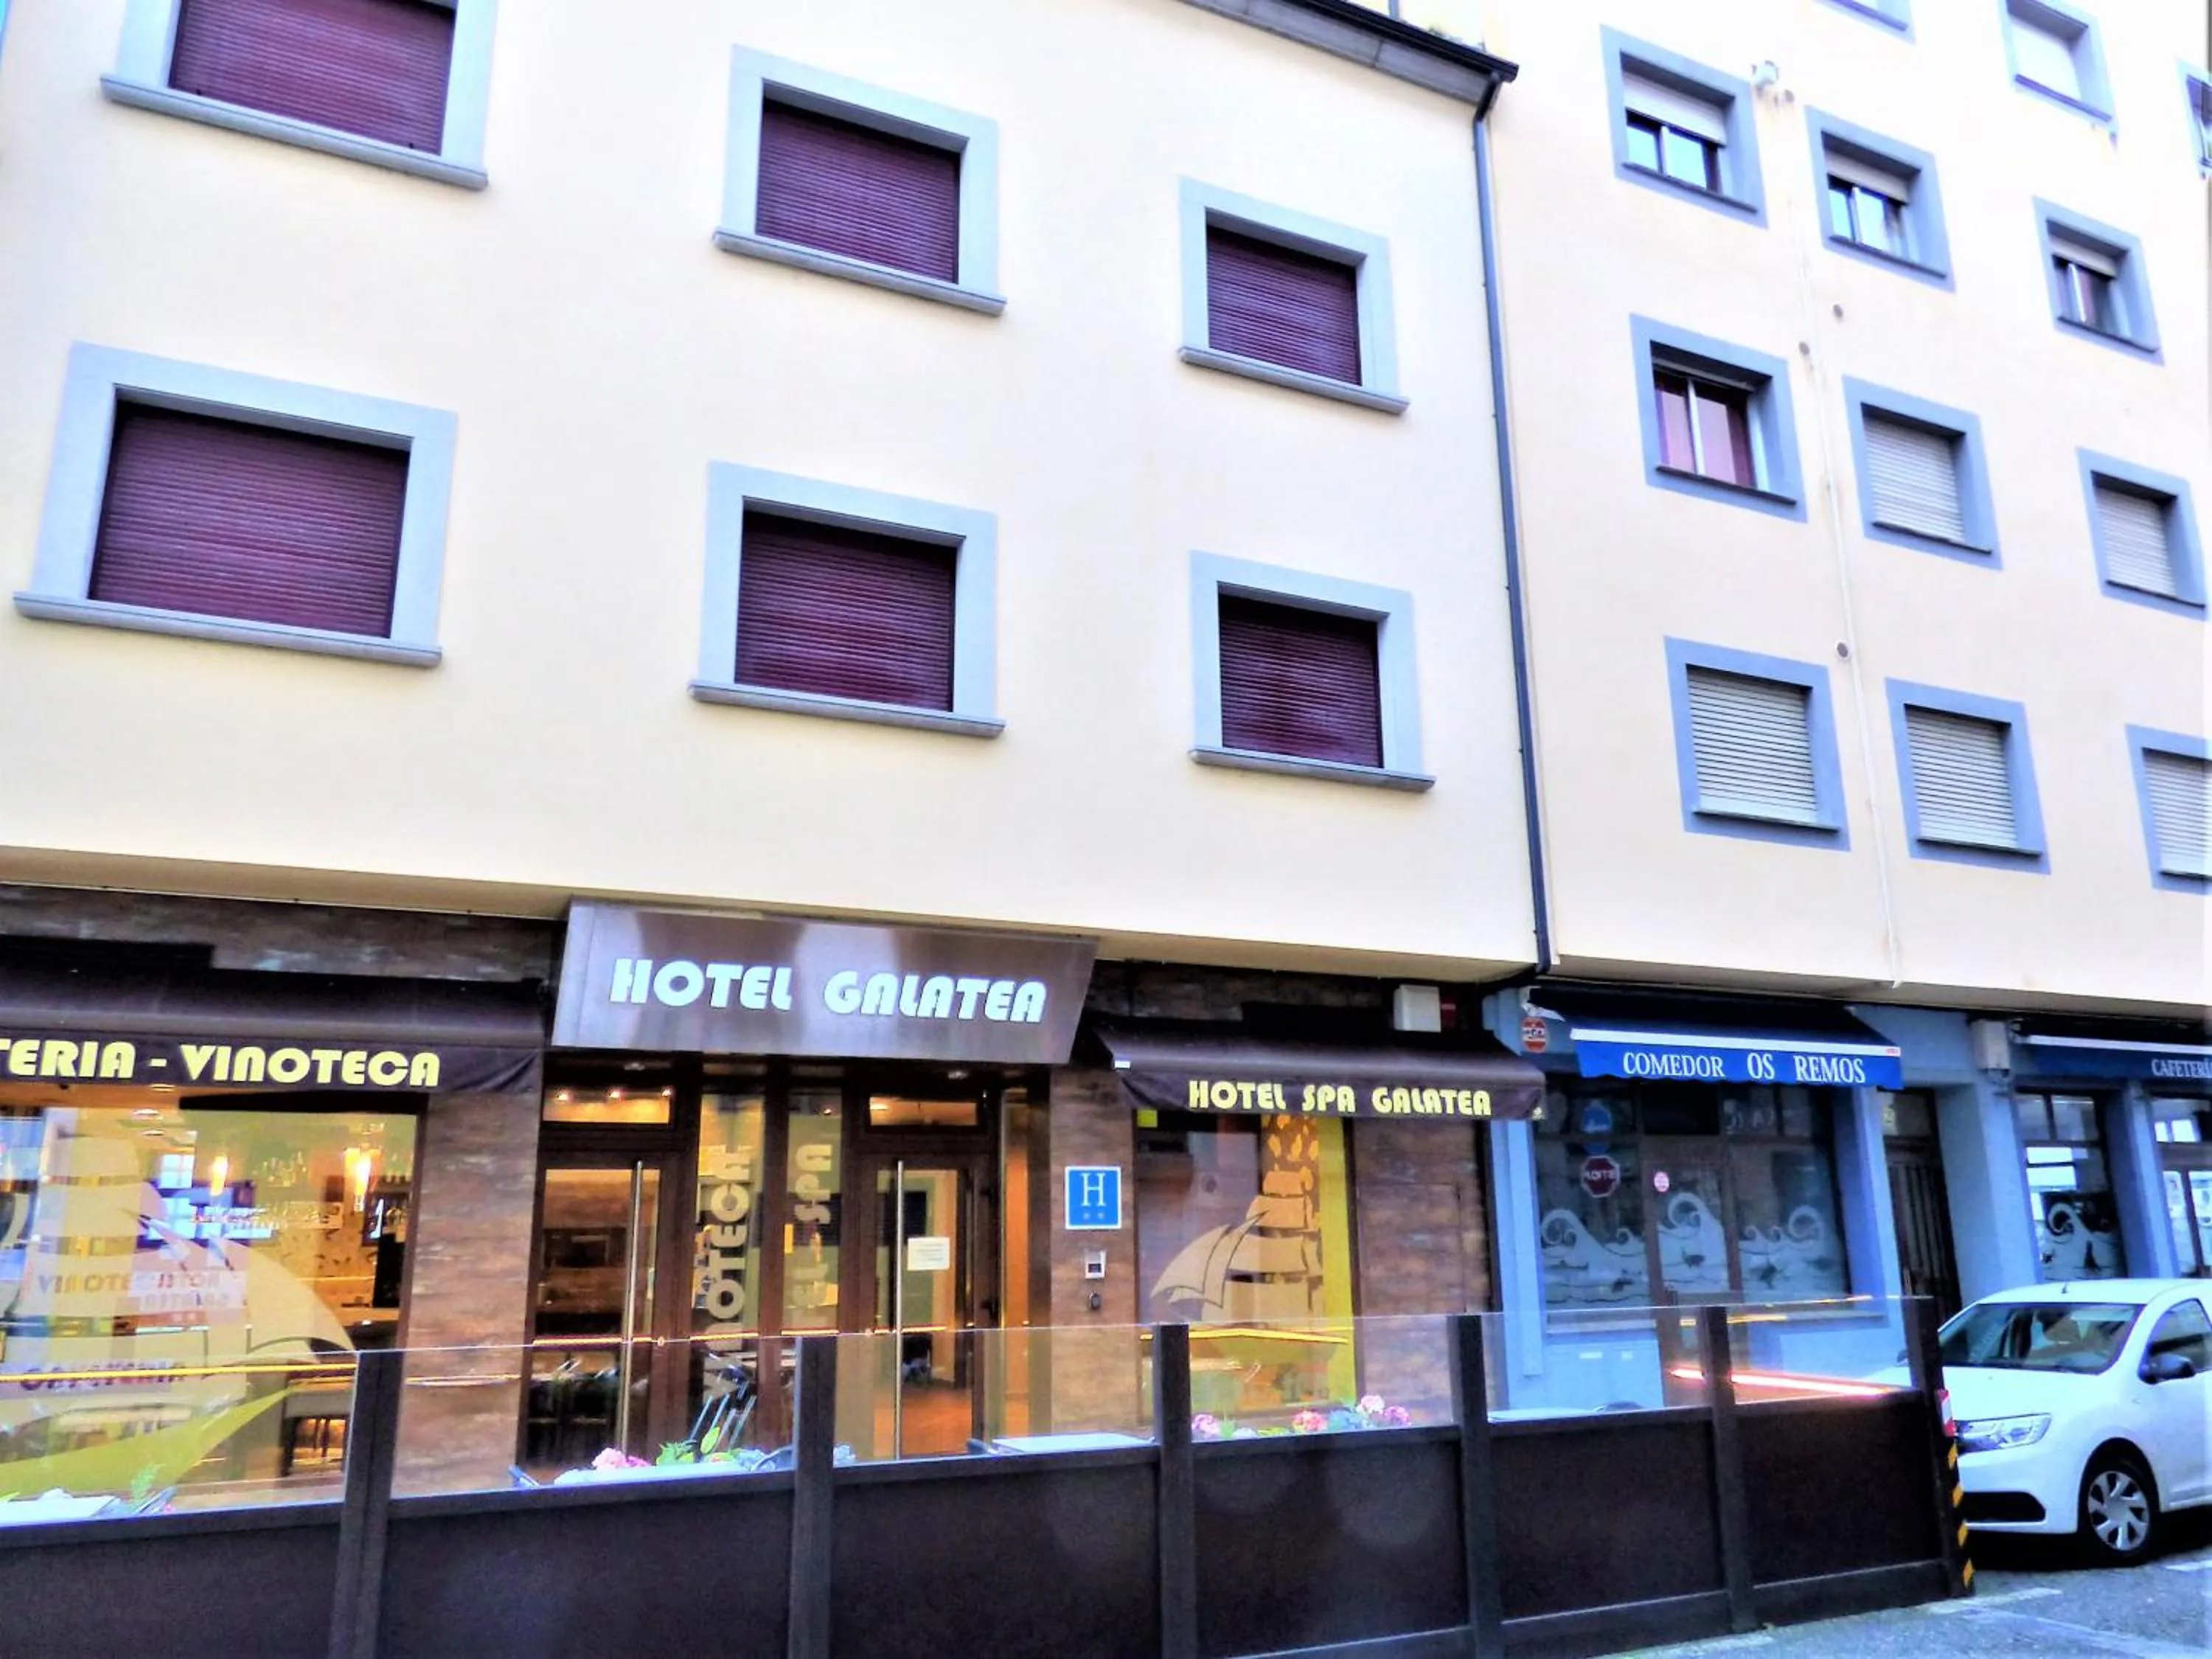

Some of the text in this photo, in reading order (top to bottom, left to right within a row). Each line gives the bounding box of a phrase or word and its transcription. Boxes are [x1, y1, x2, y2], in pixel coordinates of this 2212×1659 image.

[610, 957, 1047, 1023] HOTEL GALATEA
[179, 1044, 441, 1088] VINOTECA
[1623, 1052, 1866, 1084] COMEDOR OS REMOS
[1189, 1079, 1492, 1116] HOTEL SPA GALATEA
[1081, 1172, 1106, 1207] H
